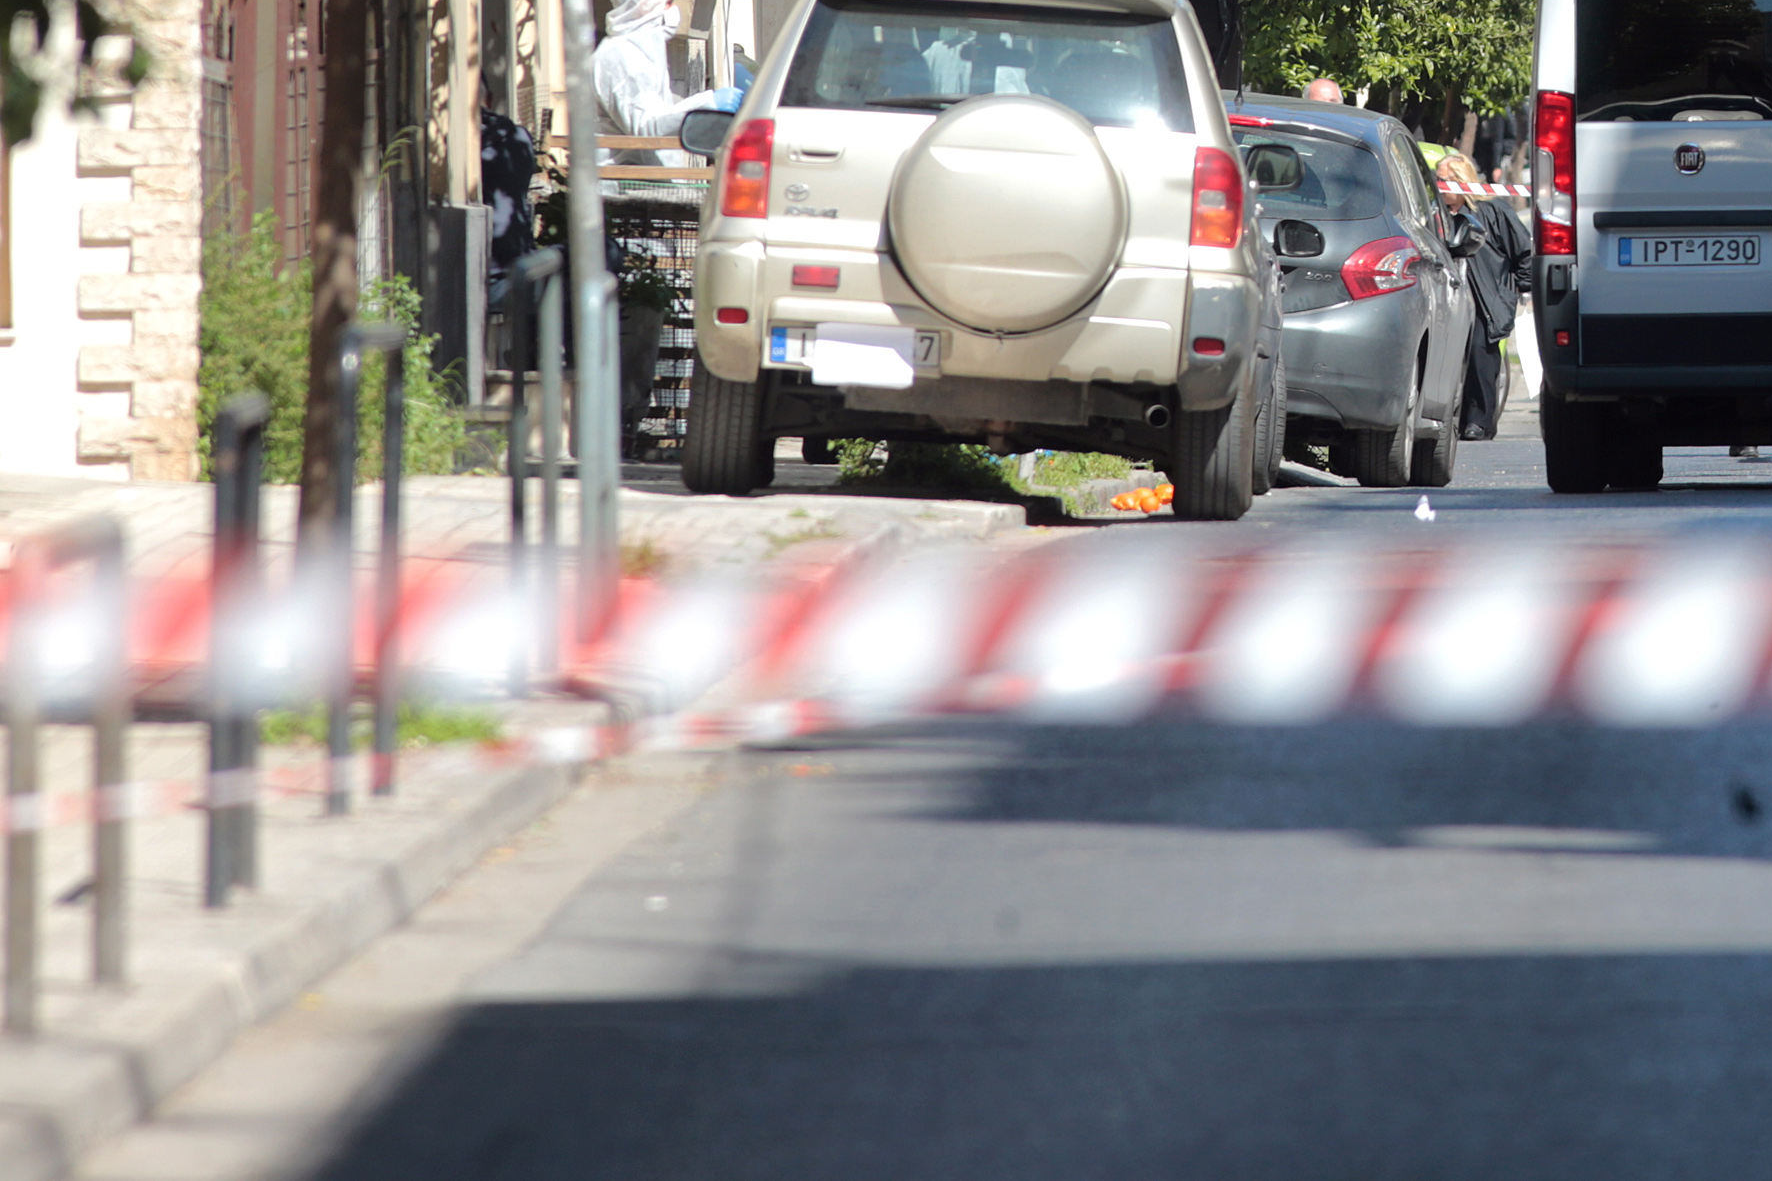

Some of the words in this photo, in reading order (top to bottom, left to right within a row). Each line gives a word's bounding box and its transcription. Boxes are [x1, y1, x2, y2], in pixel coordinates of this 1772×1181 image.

[1680, 152, 1699, 166] FIAT
[1643, 239, 1756, 262] IPT-1290
[772, 346, 785, 356] GR
